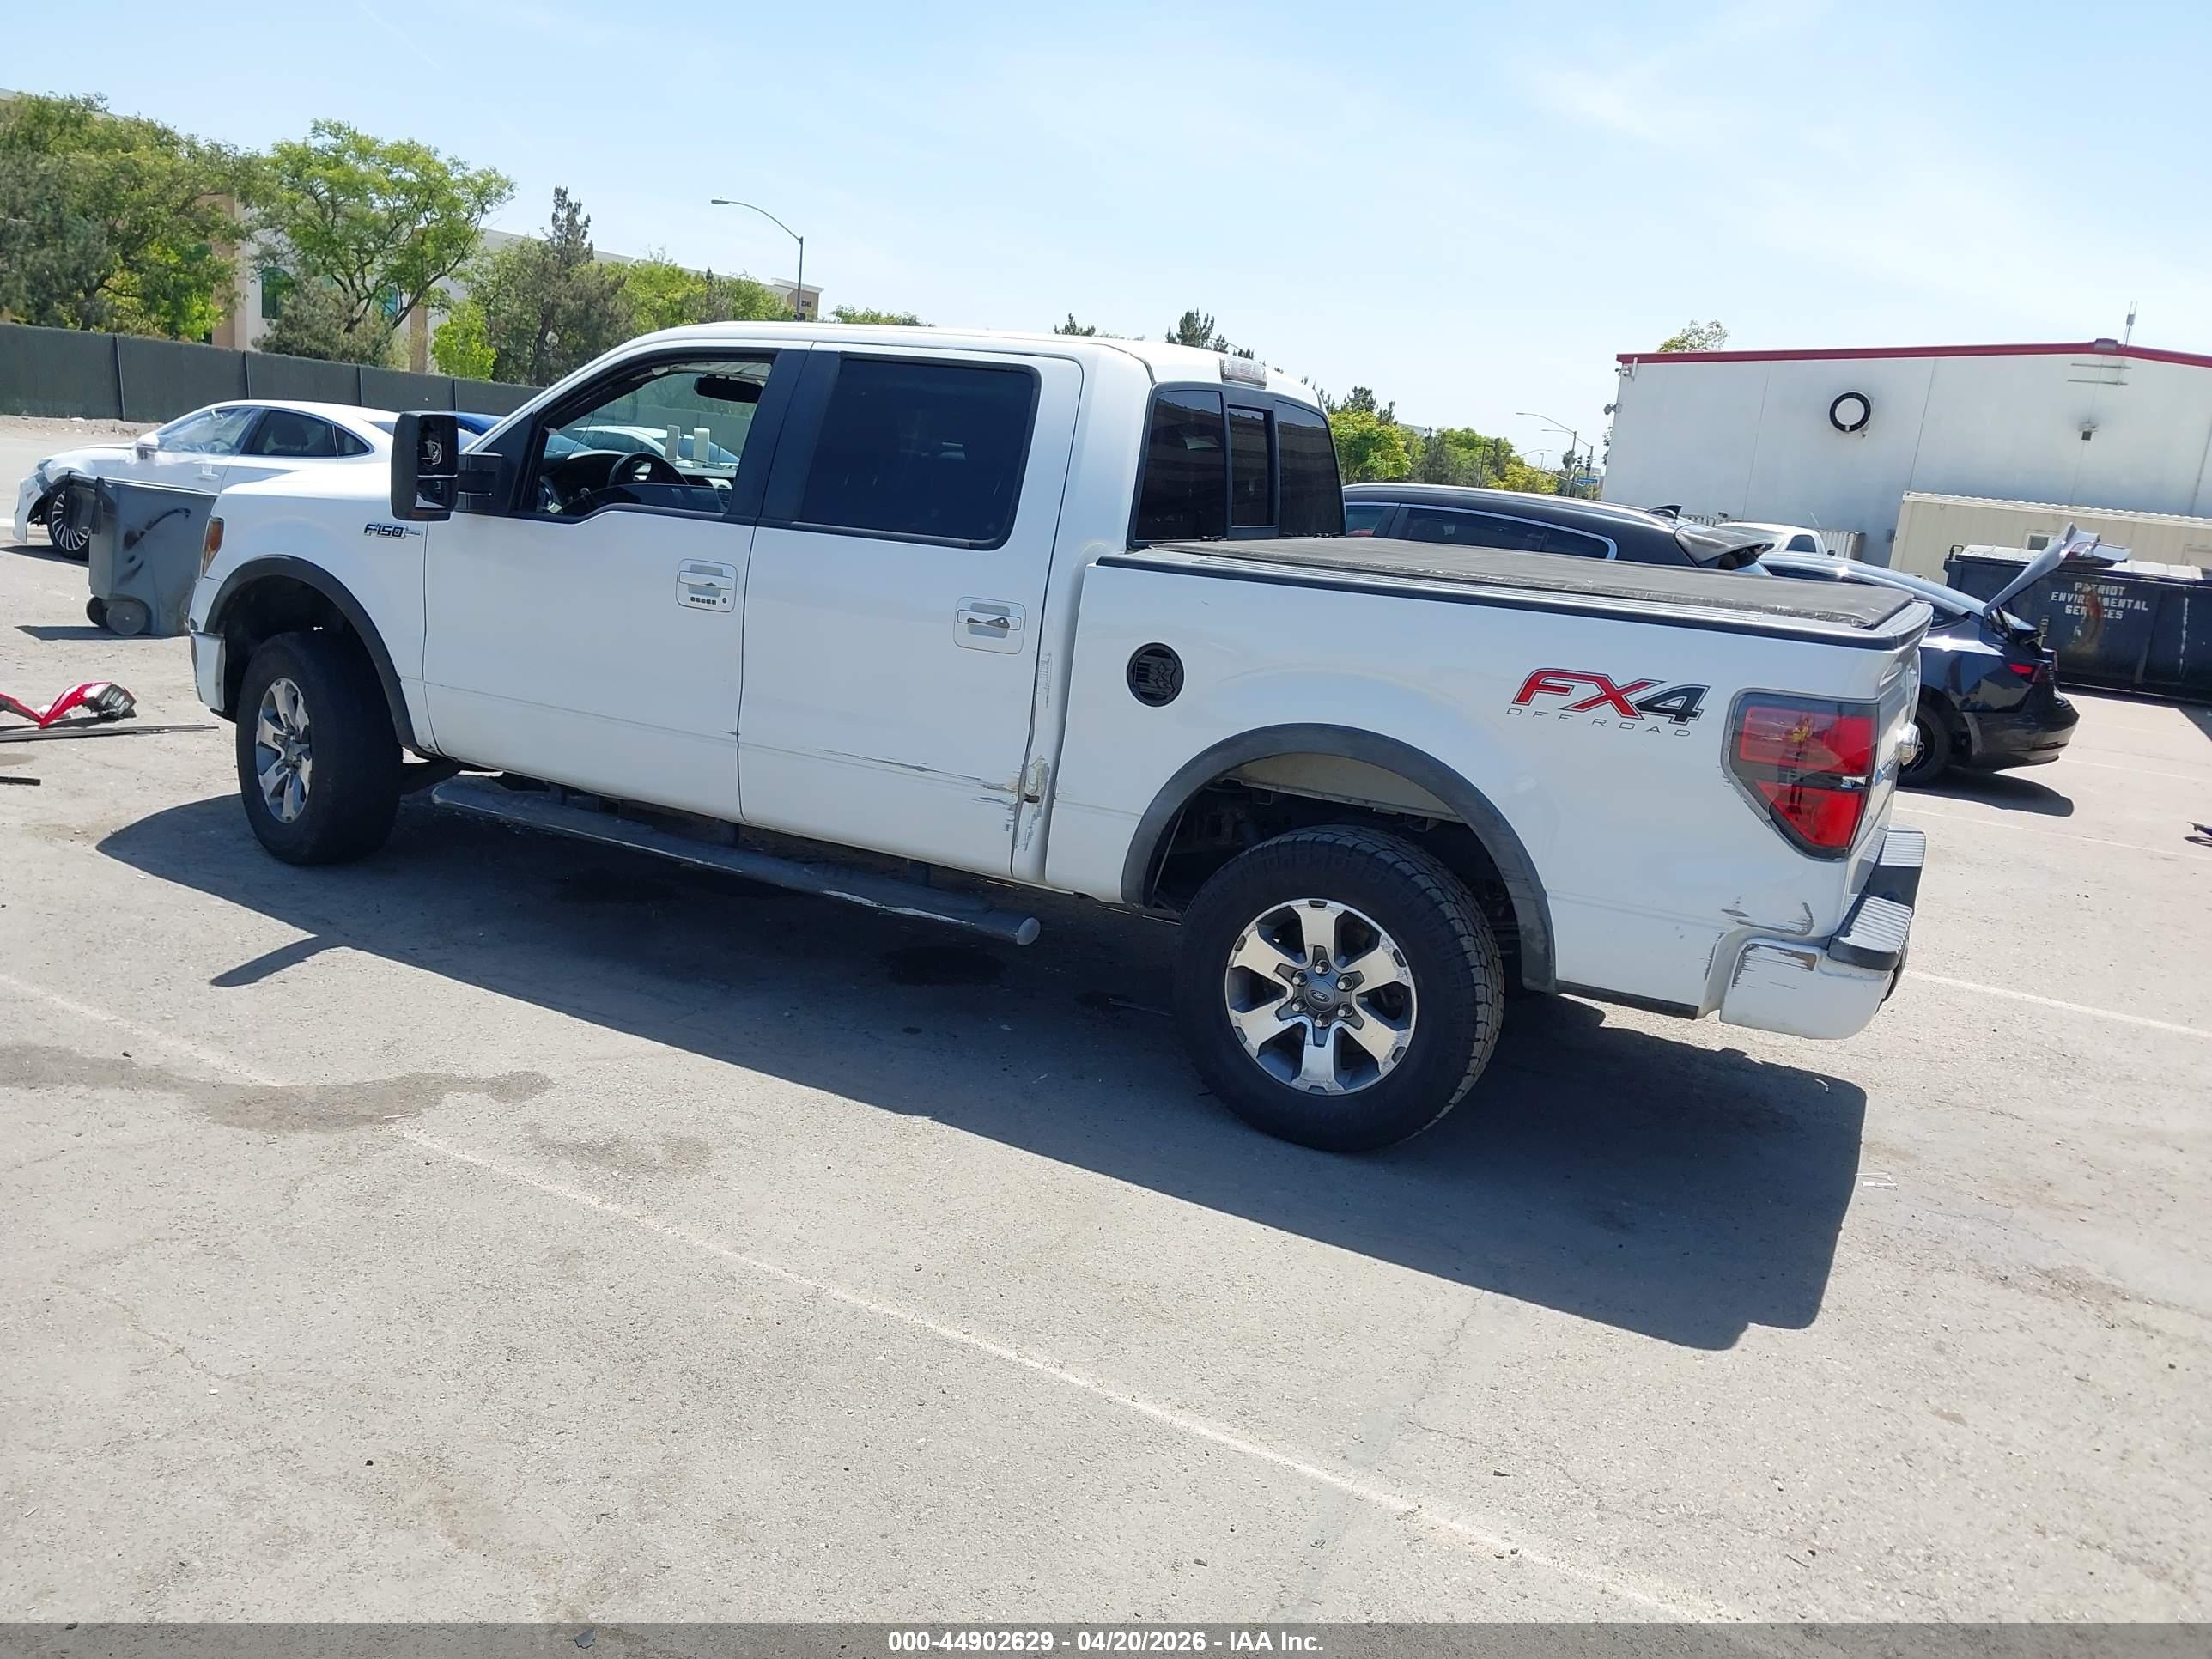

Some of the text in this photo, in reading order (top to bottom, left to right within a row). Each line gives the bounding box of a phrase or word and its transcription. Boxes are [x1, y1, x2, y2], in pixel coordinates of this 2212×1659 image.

[2050, 591, 2148, 611] ENVIRMENTAL
[2074, 581, 2126, 597] PATRIOT
[1511, 667, 1711, 726] FX4
[1506, 708, 1691, 737] OFF ROAD
